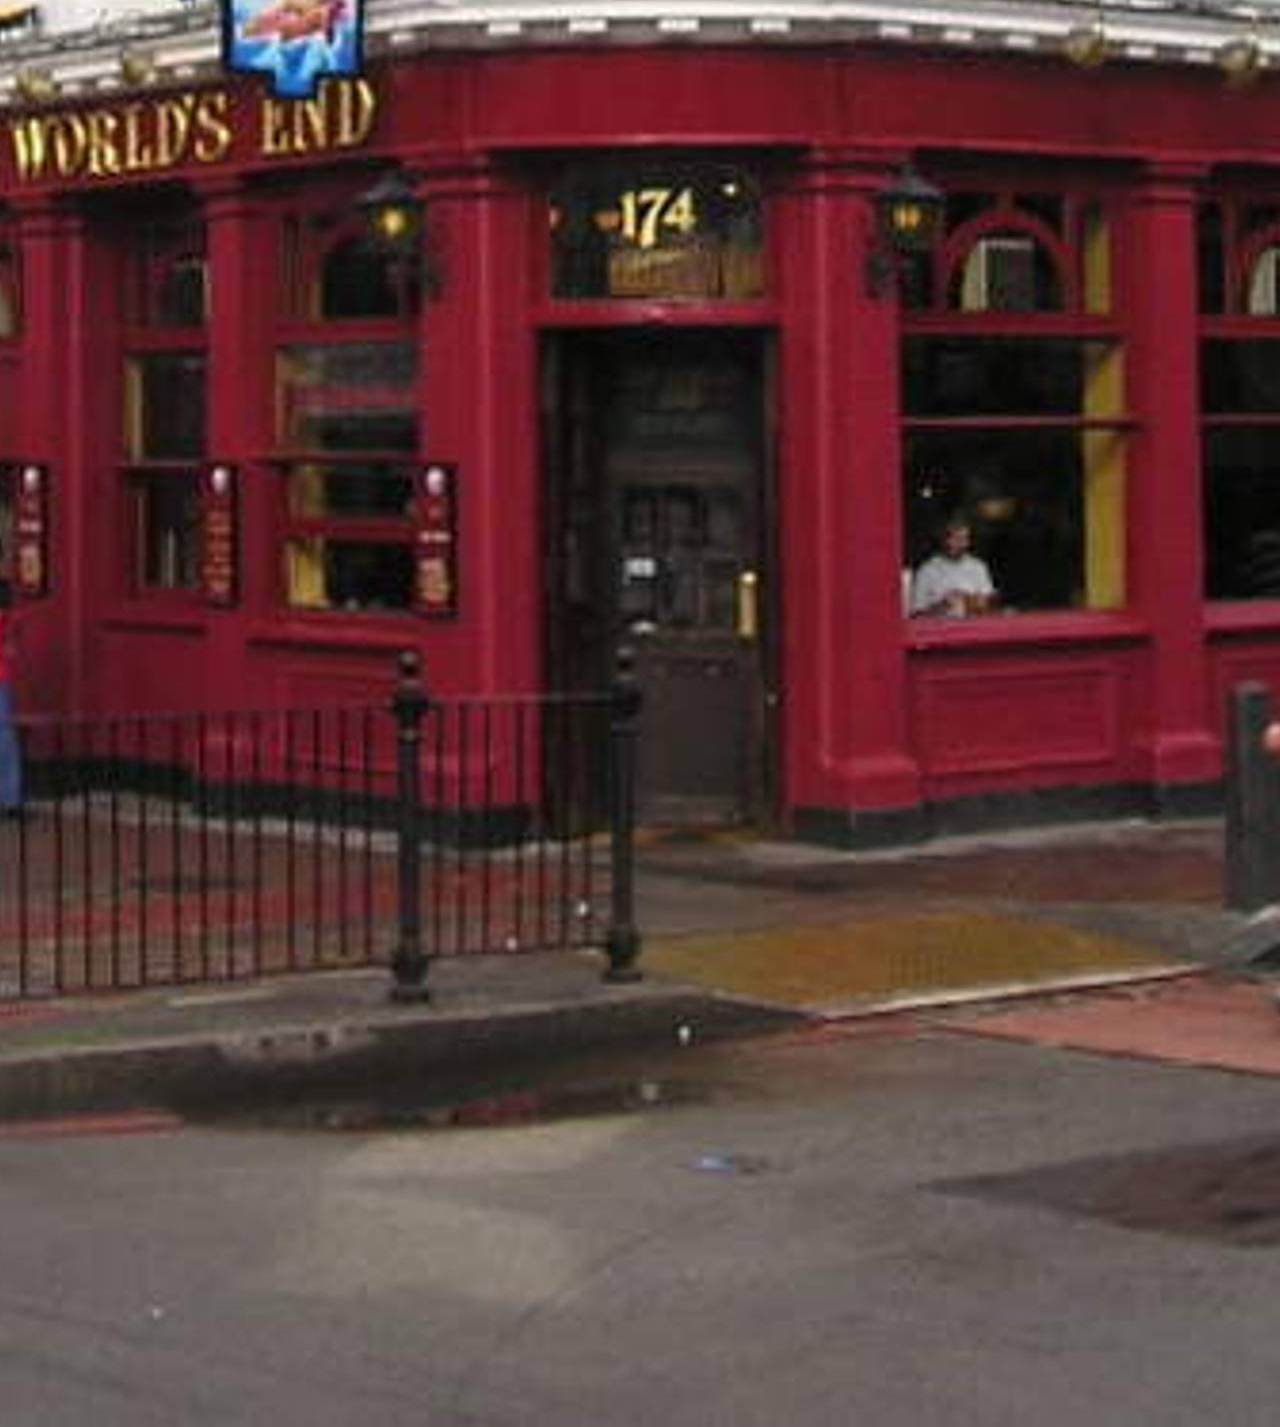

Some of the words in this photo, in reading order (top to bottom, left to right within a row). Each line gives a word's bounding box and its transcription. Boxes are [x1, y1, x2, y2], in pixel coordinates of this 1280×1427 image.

[11, 90, 233, 178] WORLD'S
[261, 76, 376, 155] END
[621, 186, 697, 250] 174
